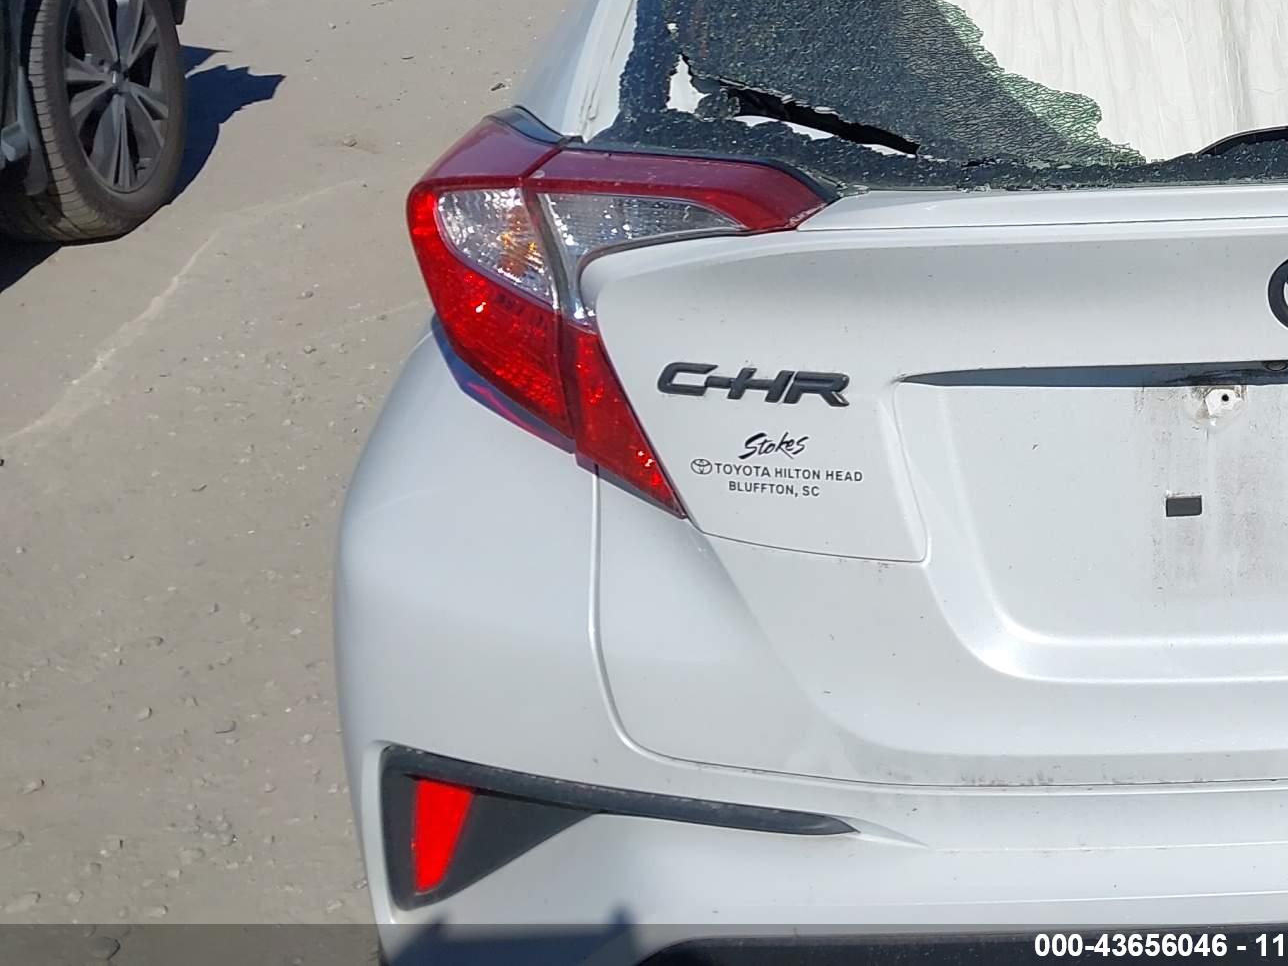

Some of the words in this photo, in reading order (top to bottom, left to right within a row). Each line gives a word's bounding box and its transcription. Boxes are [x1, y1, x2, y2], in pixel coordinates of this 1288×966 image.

[657, 362, 850, 407] C-HR
[738, 431, 809, 460] Stokes
[715, 462, 771, 478] TOYOTA
[774, 466, 821, 480] HILTON
[825, 469, 863, 482] HEAD
[728, 480, 798, 498] BLUFFTON,
[802, 485, 820, 497] SC
